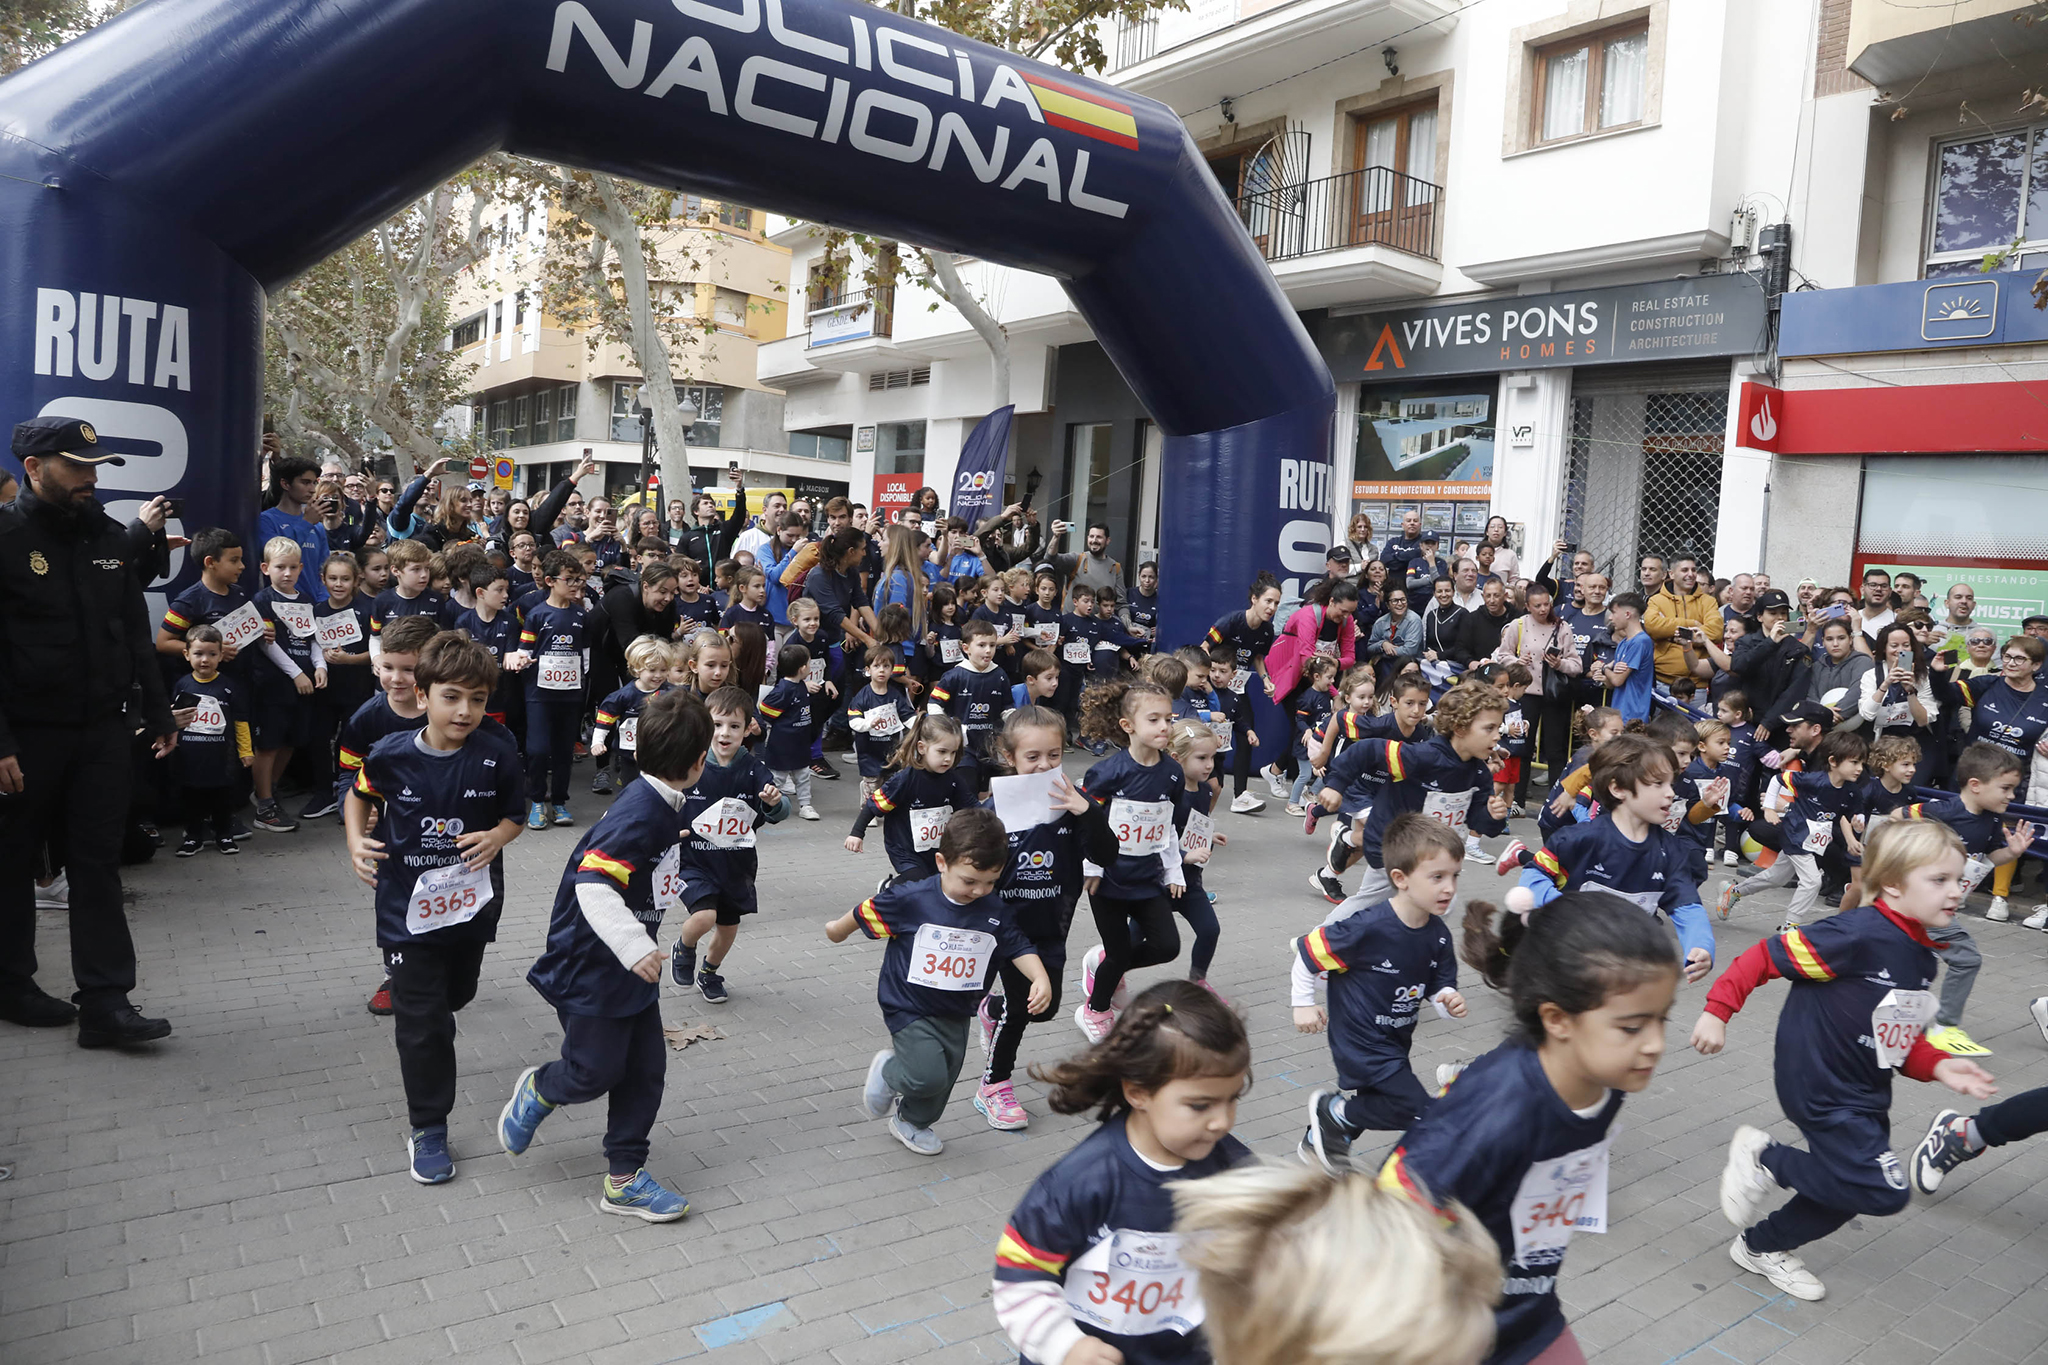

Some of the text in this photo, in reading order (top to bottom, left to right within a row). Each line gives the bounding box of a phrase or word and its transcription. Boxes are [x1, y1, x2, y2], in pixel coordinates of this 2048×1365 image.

[546, 0, 1130, 219] NACIONAL
[1631, 294, 1709, 313] REAL ESTATE
[1402, 301, 1598, 351] VIVES PONS
[1630, 312, 1724, 332] CONSTRUCTION
[34, 287, 192, 392] RUTA
[1628, 332, 1718, 350] ARCHITECTURE
[1499, 339, 1596, 361] HOMES
[1512, 425, 1532, 438] VP
[805, 484, 830, 494] MACSON
[886, 482, 907, 492] LOCAL
[958, 470, 995, 493] 200
[1279, 458, 1333, 514] RUTA
[1354, 484, 1492, 496] ESTUDIO DE ARQUITECTURA Y CONSTRUCCIÓN
[879, 491, 914, 503] DISPONIBLE
[1946, 573, 2039, 586] BIENESTANDO
[1971, 605, 2036, 620] MUSIC
[225, 616, 259, 644] 3153
[319, 623, 355, 642] 3058
[544, 669, 578, 682] 3023
[191, 711, 220, 726] 040
[920, 825, 946, 842] 304
[1117, 823, 1165, 844] 3143
[1017, 850, 1055, 870] 200
[418, 887, 477, 919] 3365
[922, 953, 977, 979] 3403
[1521, 1191, 1586, 1235] 340
[1088, 1270, 1186, 1315] 3404
